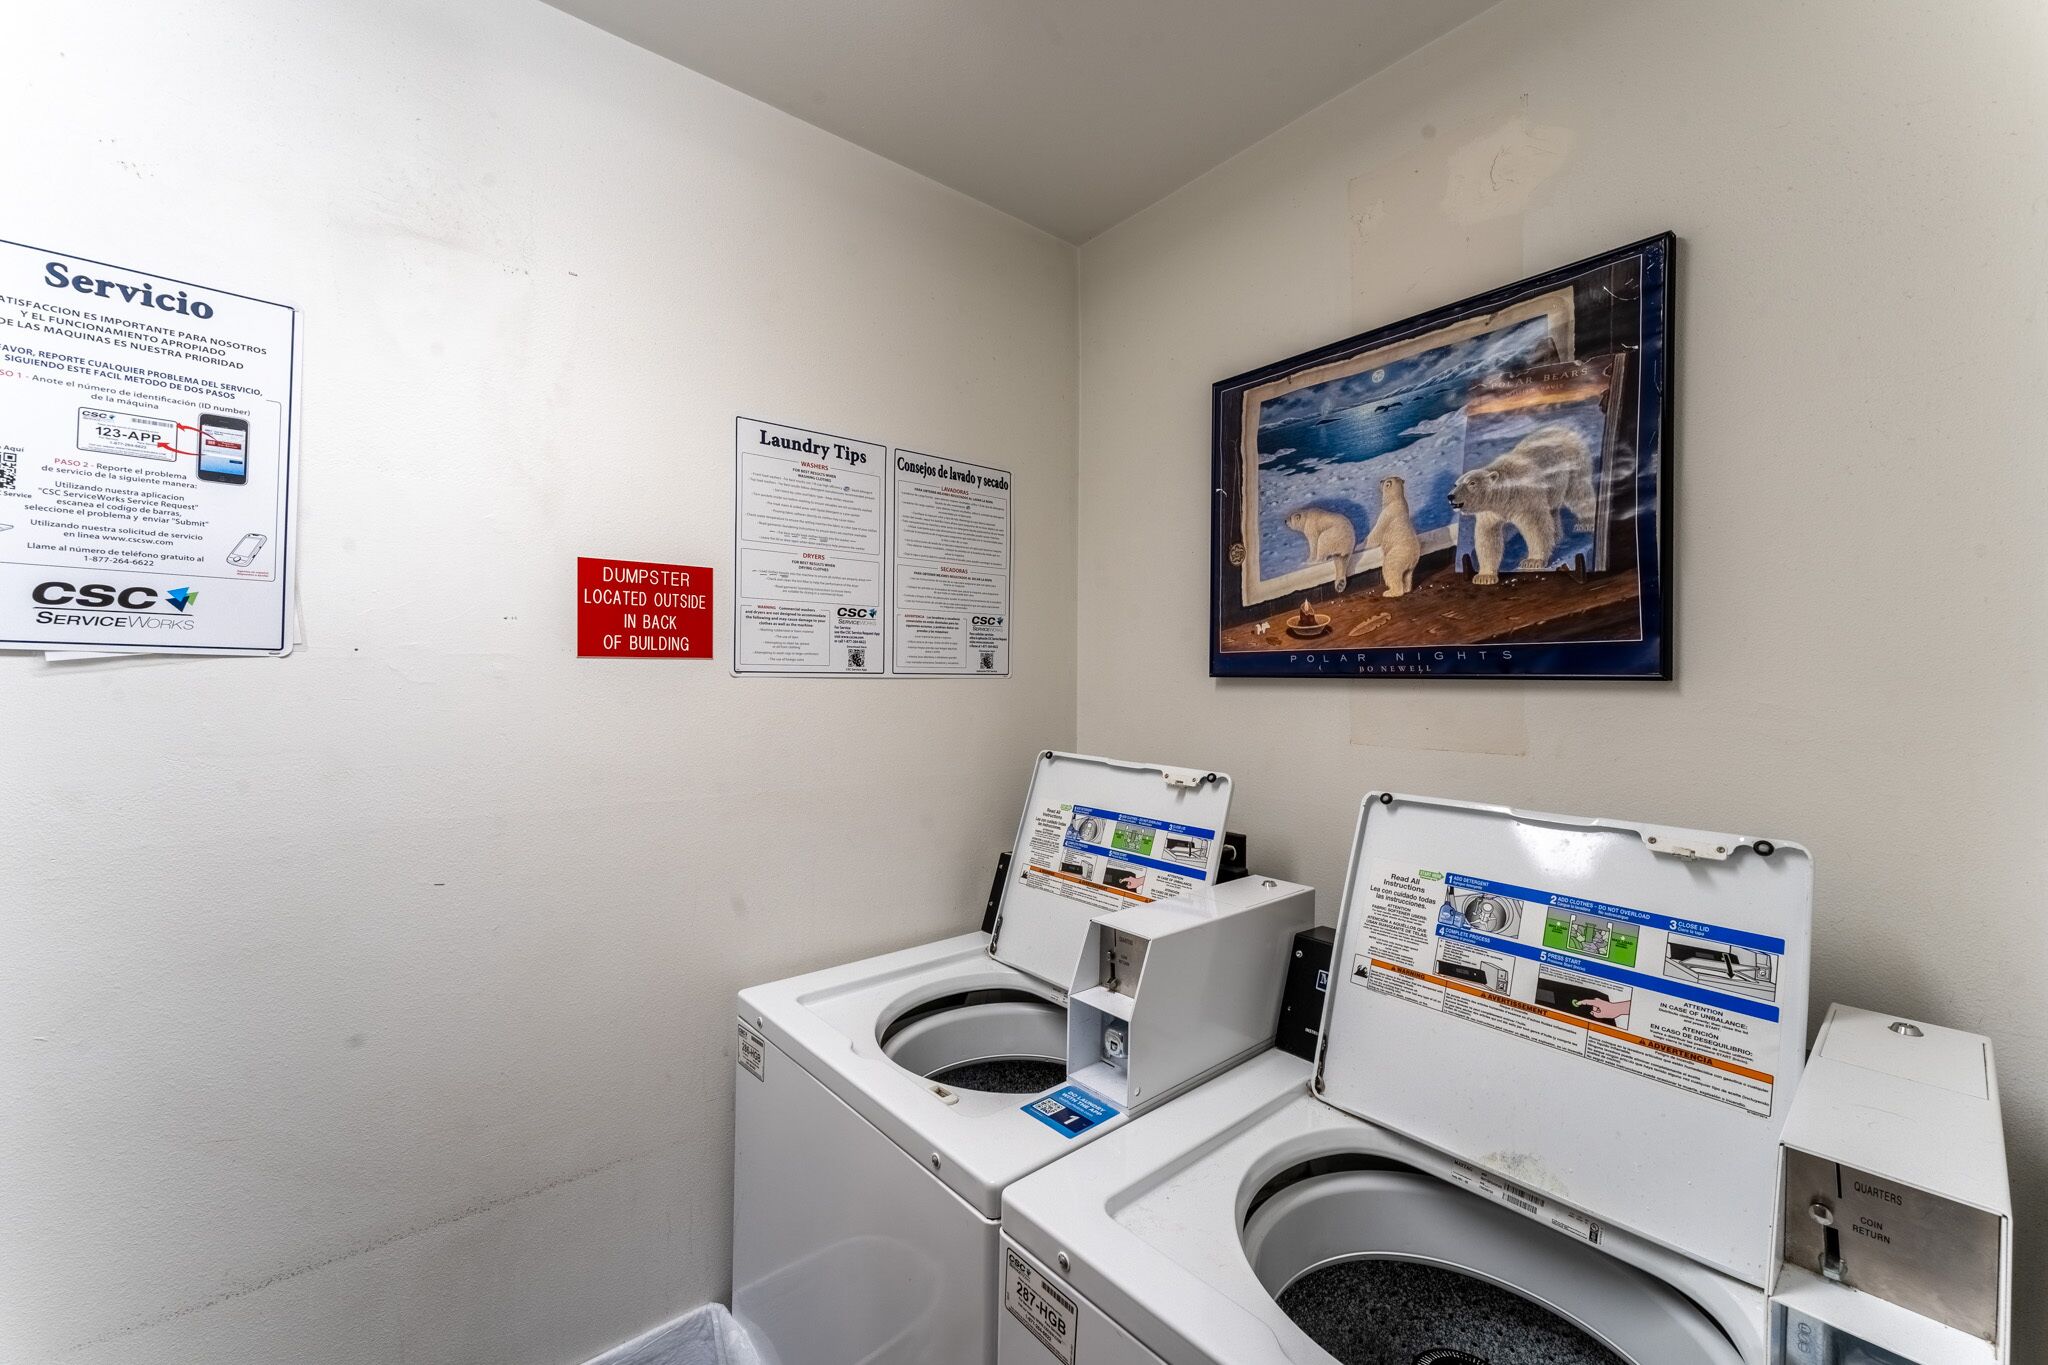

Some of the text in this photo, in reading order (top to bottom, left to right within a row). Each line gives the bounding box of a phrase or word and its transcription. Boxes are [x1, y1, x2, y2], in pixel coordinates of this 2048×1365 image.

[45, 261, 214, 320] Servicio
[20, 310, 226, 356] Y EL FUNCIONAMIENTO APROPIADO
[84, 312, 267, 355] ES IMPORTANTE PARA NOSOTROS
[18, 320, 244, 370] LAS MAQUINAS ES NUESTRA PRIORIDAD
[4, 354, 235, 400] SIGUIENDO ESTE FACIL METODO DE DOS PASOS
[39, 350, 262, 396] REPORTE CUALQUIER PROBLEMA DEL SERVICIO,
[1491, 368, 1588, 389] POLAR BEARS
[32, 374, 250, 416] Anote el número de identificación (ID number)
[119, 396, 159, 410] máquina
[82, 410, 107, 419] CSC
[95, 427, 161, 443] 123-APP
[760, 429, 867, 466] Laundry Tips
[54, 458, 187, 480] PASO Reporte problema
[801, 461, 829, 471] WASHERS
[897, 457, 1009, 490] Consejos de lavado y secado
[56, 467, 92, 476] servicio
[119, 475, 160, 485] siguiente
[162, 481, 197, 489] manera:
[3, 490, 32, 499] Service
[55, 481, 184, 501] Utilizando nuestra aplicacion
[941, 486, 969, 495] LAVADORAS
[56, 499, 94, 508] escanea
[107, 504, 137, 513] codigo
[153, 508, 182, 517] barras,
[64, 490, 198, 511] ServiceWorks Service Request"
[24, 504, 74, 514] seleccione
[87, 510, 131, 521] problema
[143, 516, 170, 524] enviar
[172, 518, 209, 527] "Submit"
[30, 519, 203, 541] Utilizando nuestra solicitud de servicio
[102, 535, 174, 546] www.cscsw.com
[27, 542, 56, 551] Llame
[69, 545, 106, 555] número
[121, 549, 159, 559] teléfono
[161, 553, 195, 562] gratuito
[84, 555, 154, 567] 1-877-264-6622
[802, 552, 825, 560] DRYERS
[603, 566, 690, 587] DUMPSTER
[940, 566, 968, 574] SECADORAS
[32, 581, 158, 610] CSC
[584, 588, 706, 609] LOCATED OUTSIDE
[624, 614, 677, 630] IN BACK
[837, 608, 867, 618] CSC
[971, 616, 996, 626] CSC
[603, 634, 690, 651] OF BUILDING
[1290, 650, 1513, 663] POLAR NIGHTS
[1384, 879, 1425, 893] Instructions
[1391, 873, 1409, 882] Read
[1463, 877, 1489, 887] DETERGENT
[1385, 895, 1426, 909] instrucciones.
[1394, 890, 1417, 900] cuidado
[1419, 896, 1436, 905] todas
[1550, 895, 1557, 904] 2
[1569, 899, 1594, 908] CLOTHES
[1620, 909, 1651, 920] OVERLOAD
[1439, 927, 1491, 943] 4 COMPLETE PROCESS
[1669, 920, 1710, 933] 3 CLOSE LID
[1540, 951, 1581, 965] 5 PRESS START
[1397, 967, 1425, 980] WARNING
[1488, 994, 1548, 1016] AVERTISSEMENT
[1683, 1002, 1723, 1016] ATTENTION
[1669, 1005, 1688, 1013] CASE
[1700, 1012, 1748, 1030] UNBALANCE:
[1662, 1026, 1753, 1057] CASO DESEQUILIBRIO:
[1682, 1026, 1719, 1040] ATENCIÓN
[1648, 1041, 1713, 1065] ADVERTENCIA
[1062, 1093, 1076, 1102] WITH
[1076, 1101, 1088, 1110] THE
[1088, 1107, 1103, 1116] APP
[1078, 1097, 1106, 1112] LAUNDRY
[1064, 1115, 1080, 1125] 1
[1454, 1160, 1473, 1172] MAYTAG
[1854, 1181, 1903, 1206] QUARTERS
[1860, 1216, 1883, 1231] COIN
[1853, 1225, 1891, 1244] RETURN
[1009, 1254, 1026, 1272] CSC
[1016, 1281, 1066, 1335] 287-HGB
